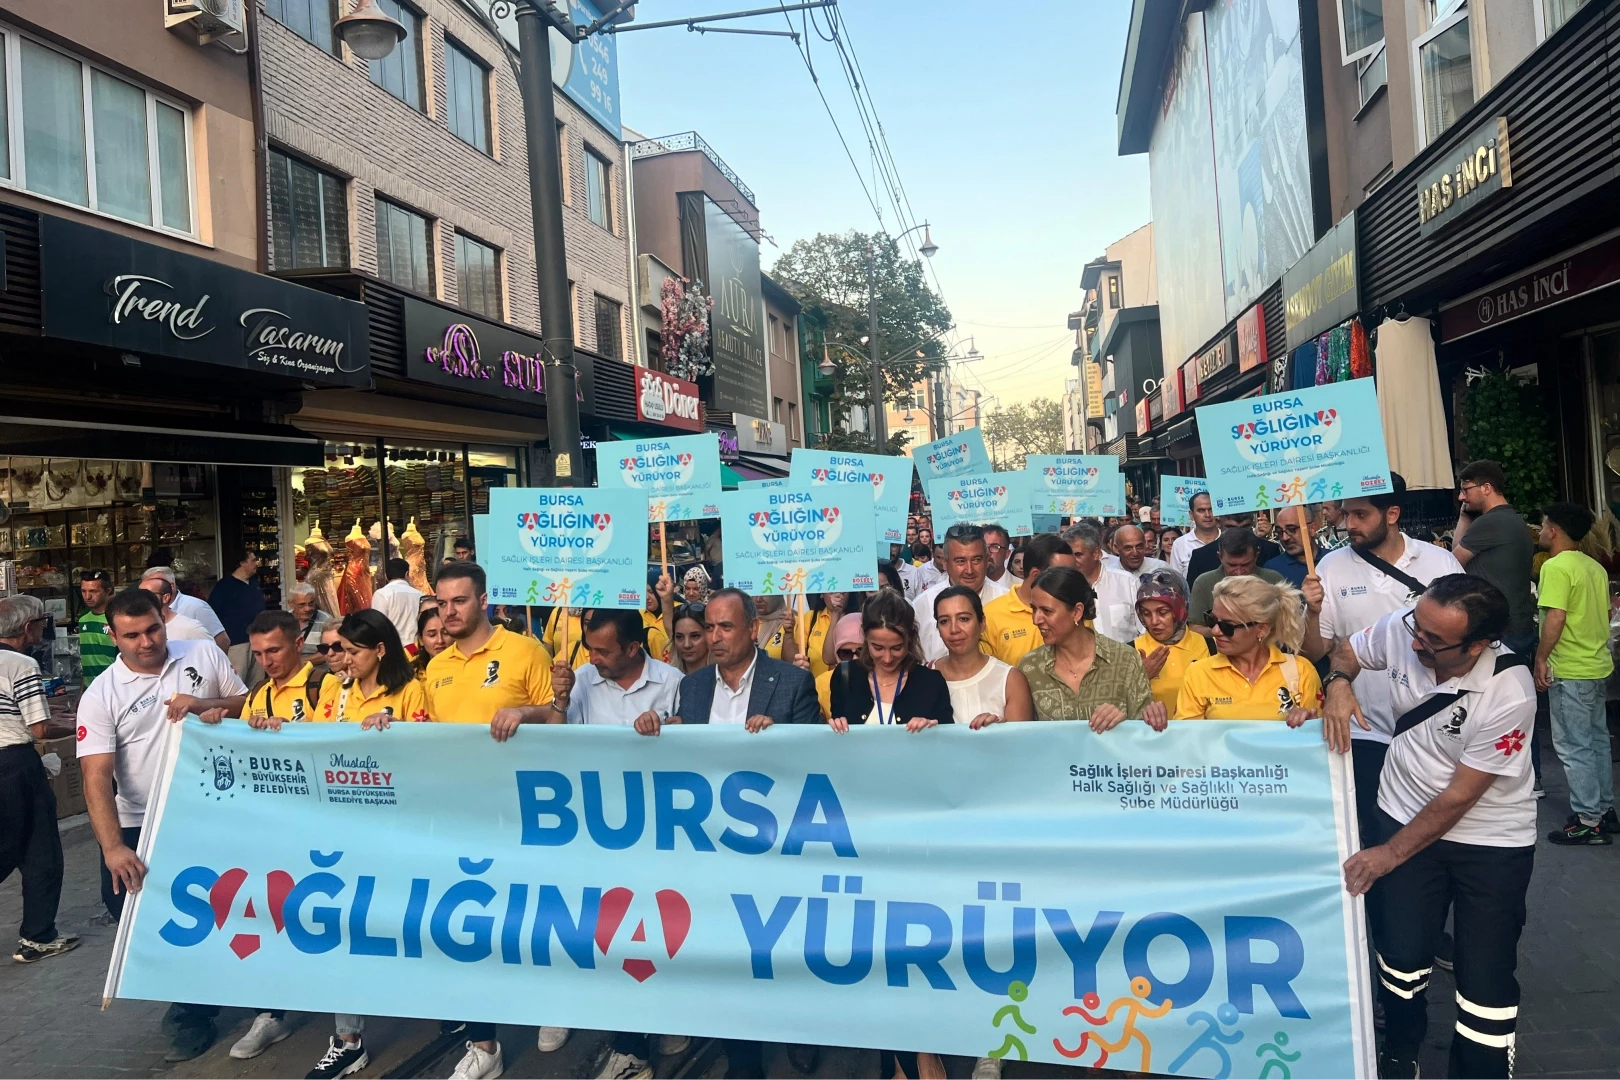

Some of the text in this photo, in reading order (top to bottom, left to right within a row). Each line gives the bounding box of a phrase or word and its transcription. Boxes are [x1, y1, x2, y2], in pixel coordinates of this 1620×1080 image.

[591, 56, 608, 86] 249
[590, 80, 602, 103] 99
[1419, 173, 1454, 225] HAS
[720, 276, 758, 335] AURA
[1496, 285, 1529, 316] HAS
[112, 274, 216, 340] Trend
[239, 308, 367, 374] Tasarım
[717, 329, 741, 357] BEAUTY
[257, 351, 271, 365] Söz
[272, 354, 278, 364] &
[296, 359, 335, 374] Organizasyon
[663, 381, 699, 420] Döner
[1252, 396, 1304, 415] BURSA
[1231, 408, 1337, 440] SAĞLIĞINA
[636, 442, 670, 452] BURSA
[932, 440, 954, 450] BURSA
[1249, 434, 1323, 455] YÜRÜYOR
[620, 453, 692, 470] SAĞLIĞINA
[830, 456, 864, 468] BURSA
[926, 444, 968, 464] SAĞLIĞINA
[1221, 446, 1370, 475] SAĞLIK İŞLERİ DAİRESİ BAŞKANLIĞI
[936, 457, 964, 470] YÜRÜYOR
[1042, 466, 1098, 476] SAĞLIĞINA
[632, 471, 681, 482] YÜRÜYOR
[811, 468, 884, 486] SAĞLIĞINA
[960, 478, 988, 486] BURSA
[540, 495, 584, 506] BURSA
[769, 493, 813, 505] BURSA
[948, 486, 1006, 501] SAĞLIĞINA
[958, 500, 998, 510] YÜRÜYOR
[516, 511, 611, 531] SAĞLIĞINA
[748, 507, 840, 528] SAĞLIĞINA
[531, 534, 594, 548] YÜRÜYOR
[763, 528, 825, 542] YÜRÜYOR
[501, 555, 633, 566] SAĞLIK İŞLERİ DAİRESİ BAŞKANLIĞI
[736, 546, 864, 559] SAĞLIK İŞLERİ DAİRESİ BAŞKANLIĞI
[249, 756, 305, 772] BURSA
[330, 752, 380, 772] Mustafa
[324, 770, 393, 786] BOZBEY
[1069, 763, 1288, 780] Sağlık İşleri Dairesi Başkanlığı
[253, 784, 310, 796] BELEDİYESİ
[352, 789, 396, 798] BÜYÜKŞEHİR
[1072, 780, 1288, 796] Halk Sağlığı ve Sağlıklı Yaşam
[329, 796, 398, 807] BELEDİYE BAŞKANI
[1120, 796, 1239, 812] Şube Müdürlüğü
[514, 769, 859, 860] BURSA
[158, 849, 1312, 1021] SAĞLIĞINA YÜRÜYOR
